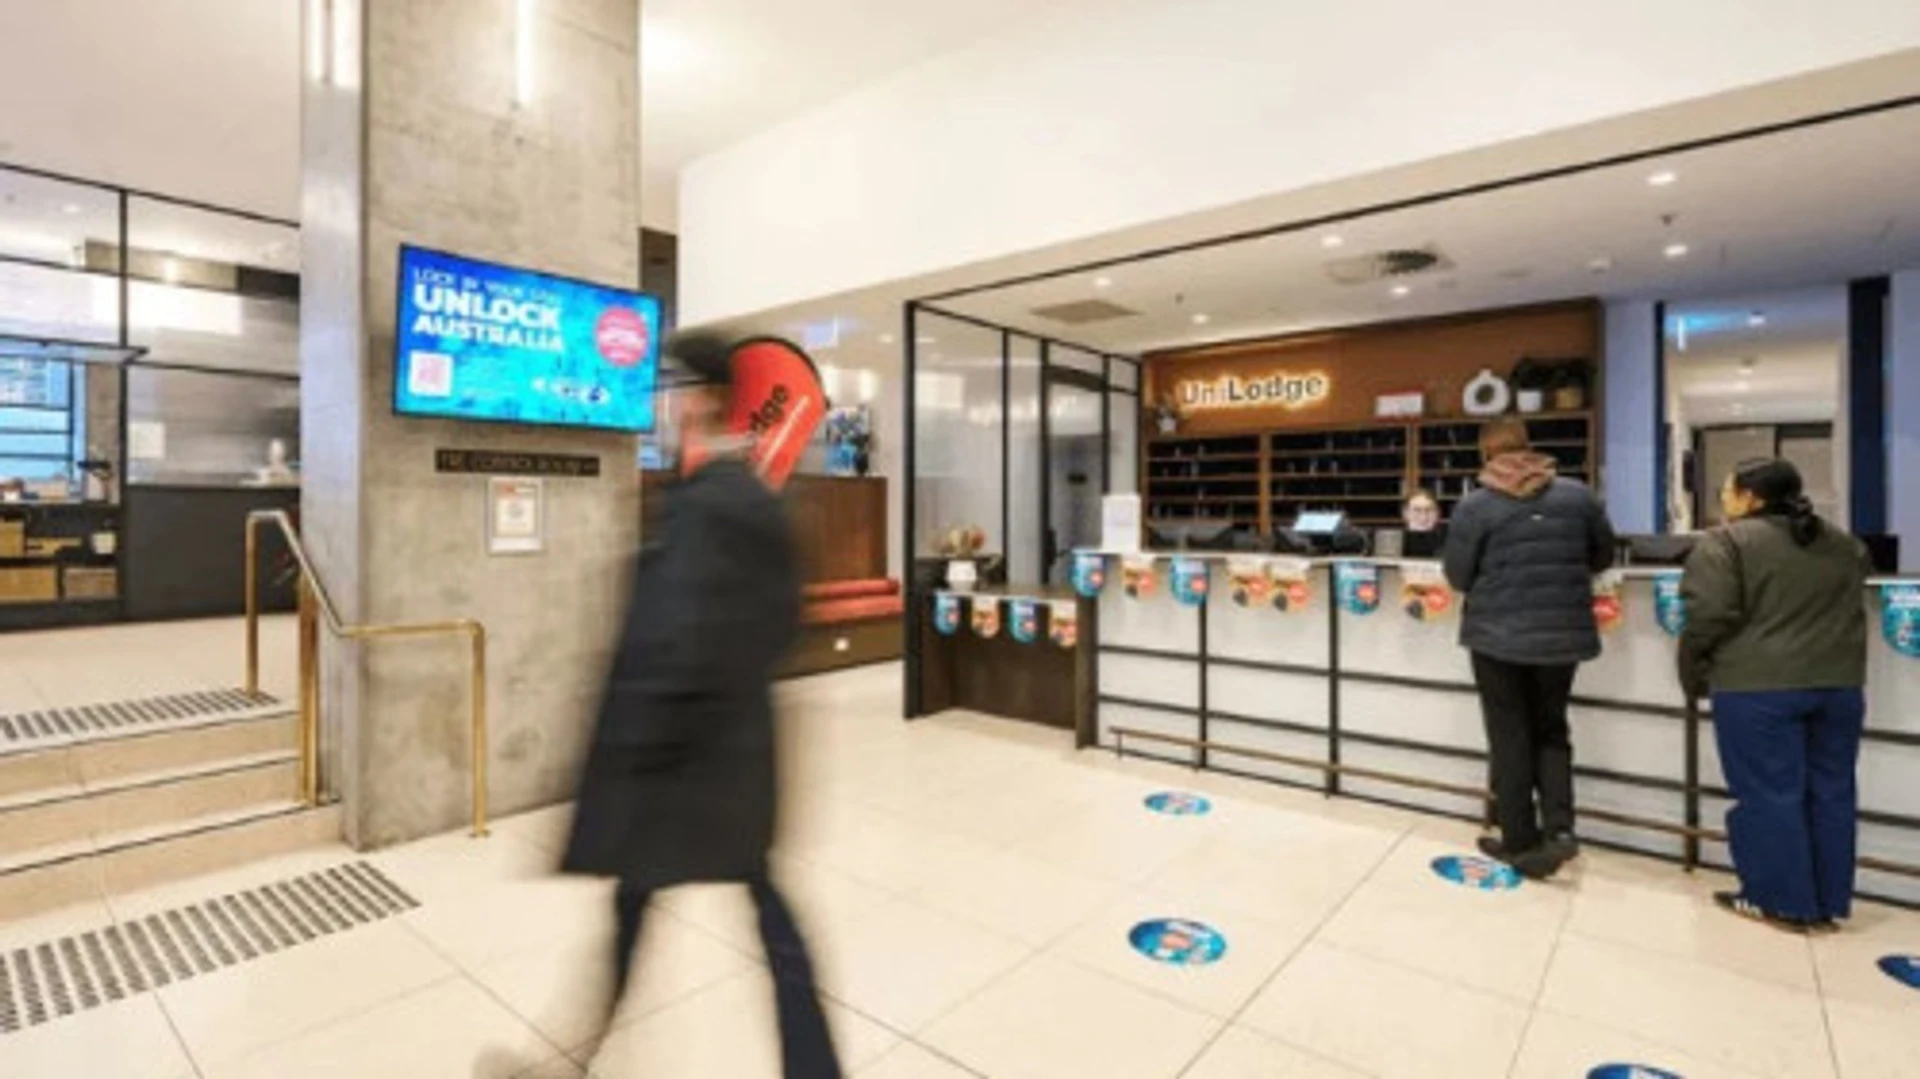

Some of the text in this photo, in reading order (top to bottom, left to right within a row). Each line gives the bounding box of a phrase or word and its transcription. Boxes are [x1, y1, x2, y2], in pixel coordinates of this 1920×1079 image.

[413, 284, 560, 330] UNLOCK
[412, 313, 565, 350] AUSTRALIA
[1182, 374, 1324, 404] UniLodge
